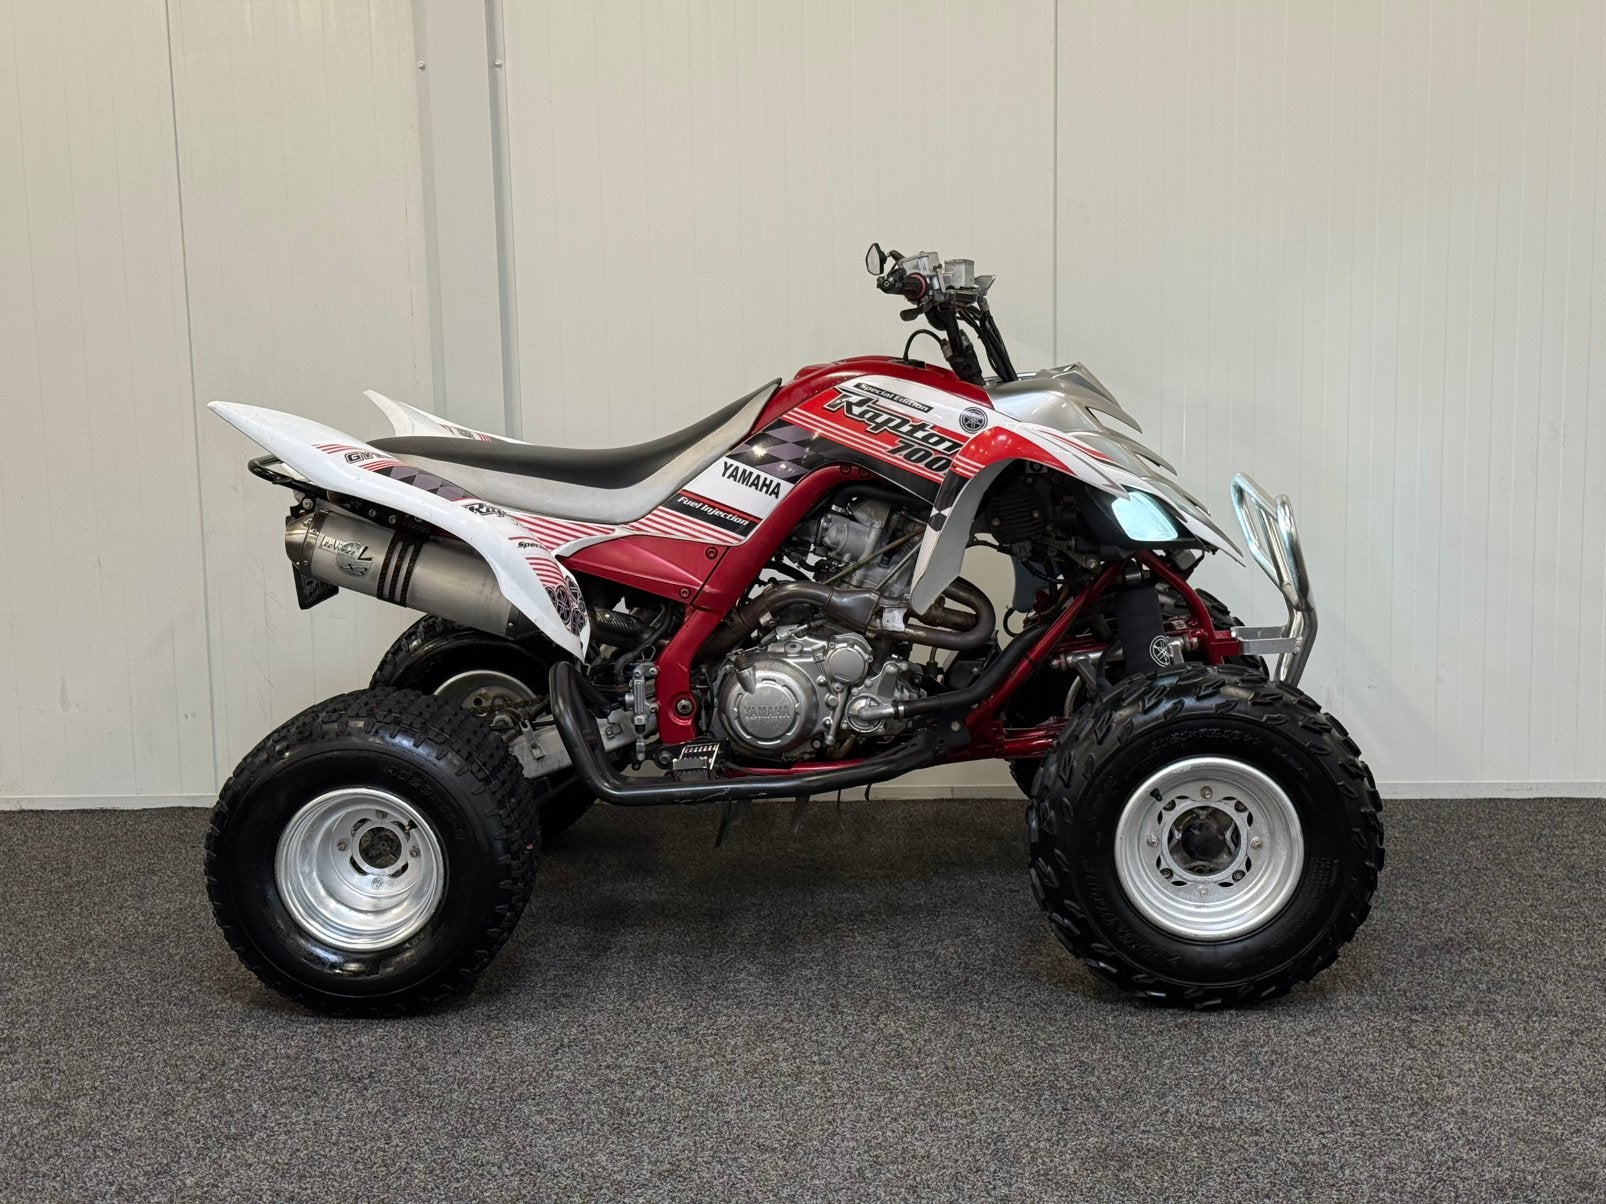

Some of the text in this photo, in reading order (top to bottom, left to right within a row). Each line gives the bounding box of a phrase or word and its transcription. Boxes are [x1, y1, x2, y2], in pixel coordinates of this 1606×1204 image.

[860, 383, 930, 412] Special Edition
[823, 387, 964, 455] Raptor
[720, 461, 782, 499] YAMAHA
[677, 496, 750, 527] Fuel Injection
[743, 705, 791, 720] YAMAHA
